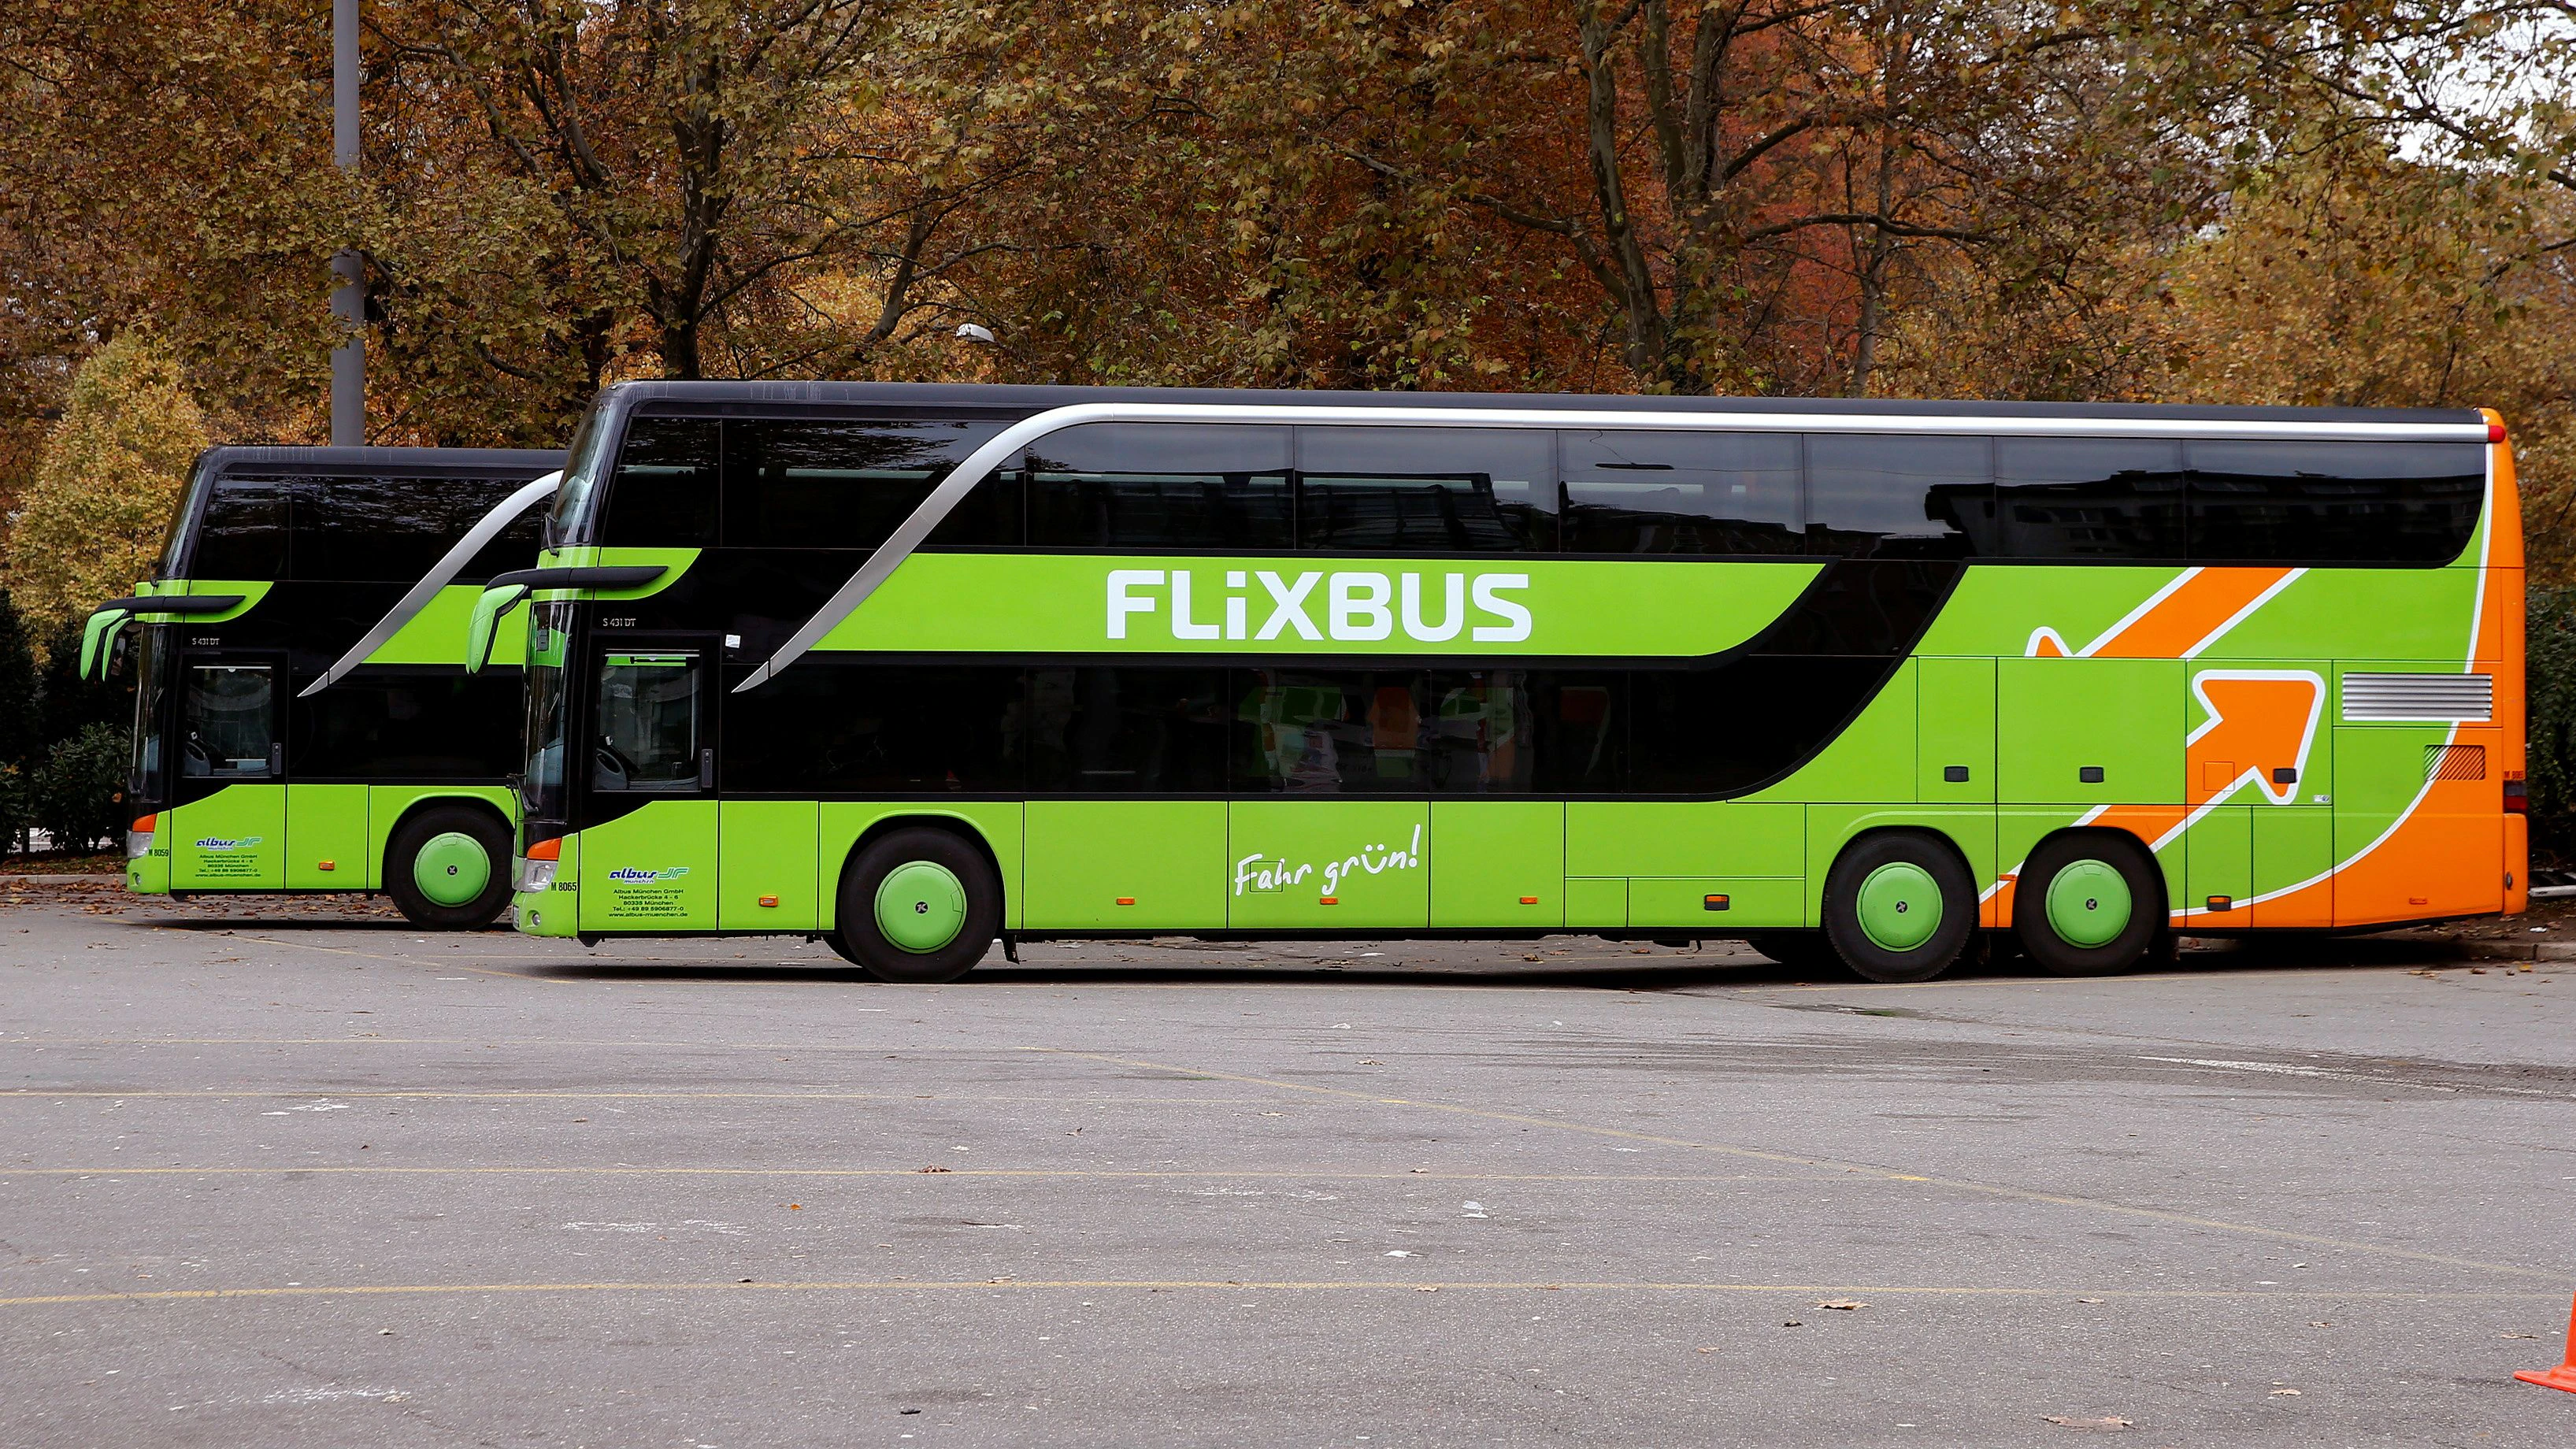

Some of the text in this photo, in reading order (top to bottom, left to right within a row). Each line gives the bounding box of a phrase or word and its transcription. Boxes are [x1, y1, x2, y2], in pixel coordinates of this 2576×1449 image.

[602, 617, 636, 627] S 431 DT
[191, 637, 197, 646] S
[196, 837, 235, 847] albus
[1234, 824, 1421, 896] Fahr grün!
[609, 868, 658, 879] albus
[550, 882, 577, 891] M 8065
